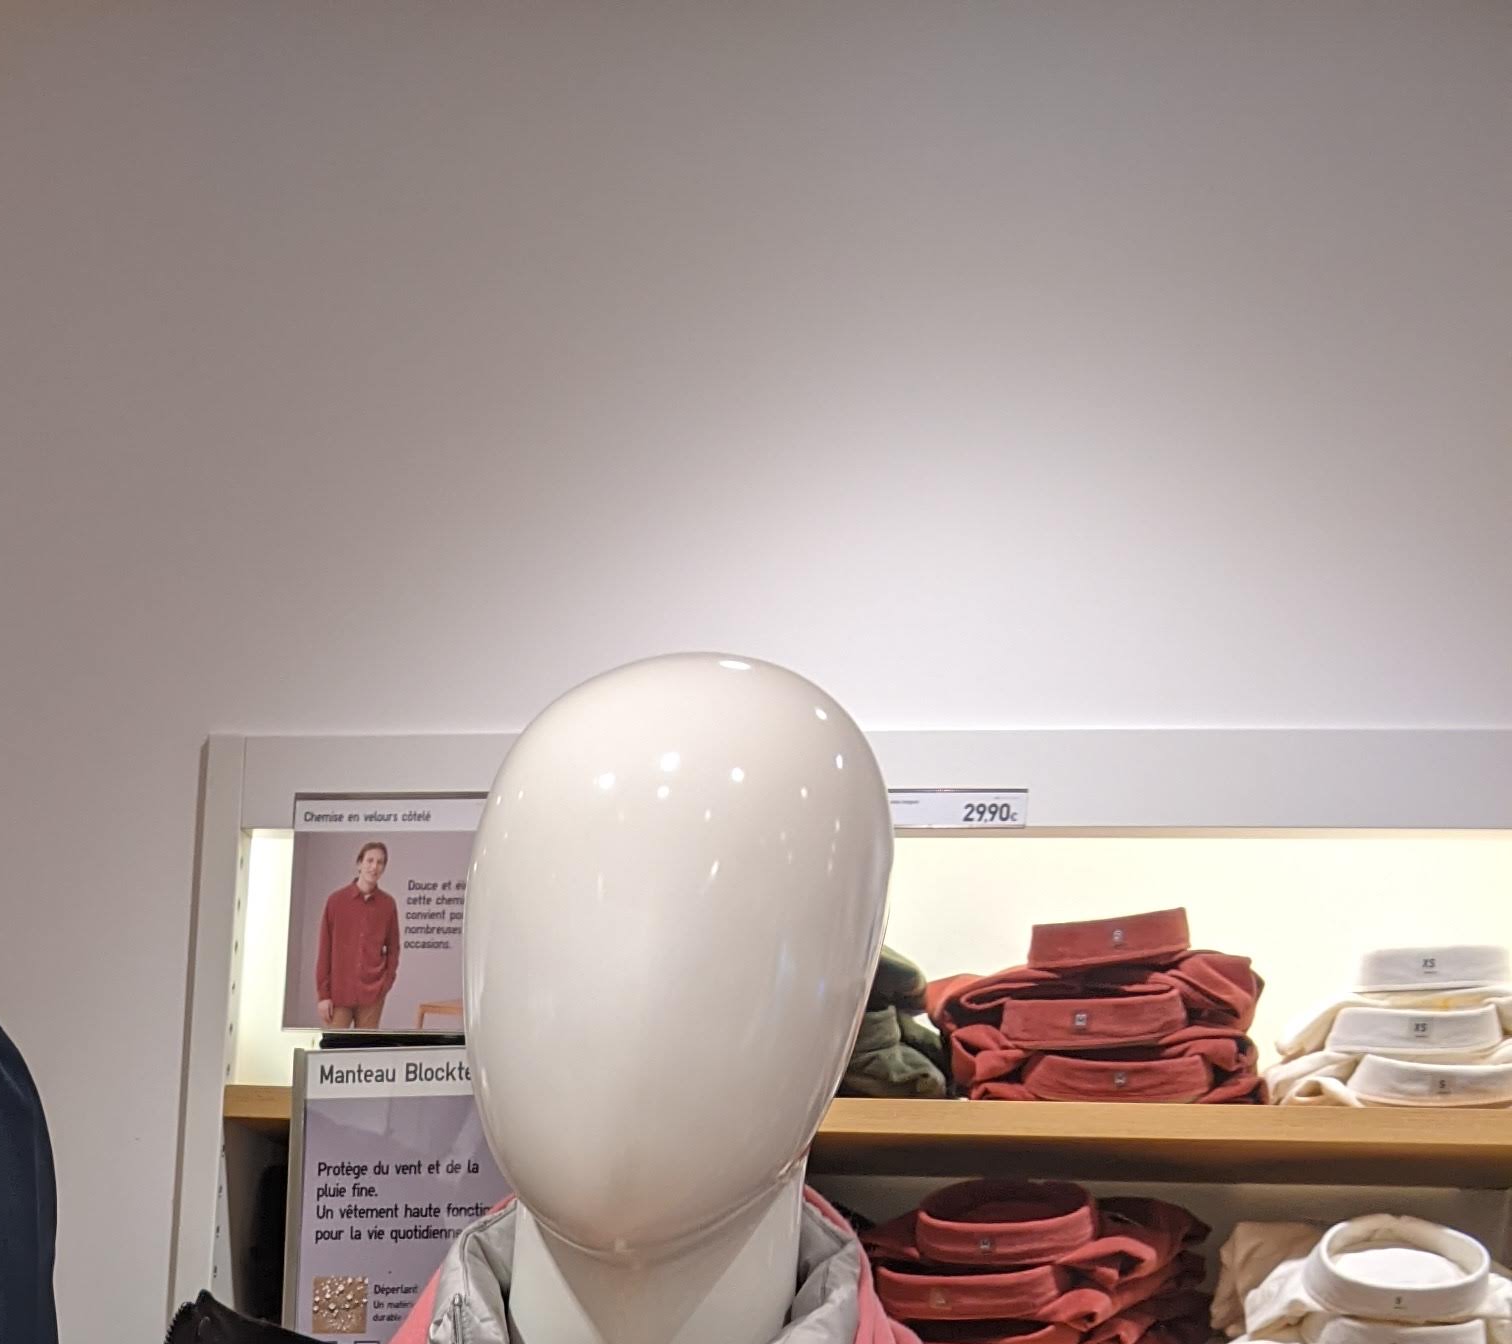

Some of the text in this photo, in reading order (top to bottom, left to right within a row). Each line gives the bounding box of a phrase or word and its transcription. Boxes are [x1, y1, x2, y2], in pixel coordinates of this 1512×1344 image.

[304, 810, 431, 823] Chemise en velours côtelé
[408, 879, 437, 891] Douce
[441, 880, 451, 891] et
[406, 895, 432, 906] cette
[405, 909, 446, 921] convient
[404, 924, 462, 935] nombreuses
[319, 1063, 396, 1085] Manteau
[317, 1159, 480, 1179] Protège du vent et de la
[316, 1183, 379, 1202] pluie fine.
[316, 1205, 334, 1219] Un
[339, 1203, 399, 1219] vêtement
[403, 1203, 441, 1219] haute
[315, 1227, 345, 1244] pour
[350, 1226, 362, 1241] la
[367, 1227, 385, 1241] vie
